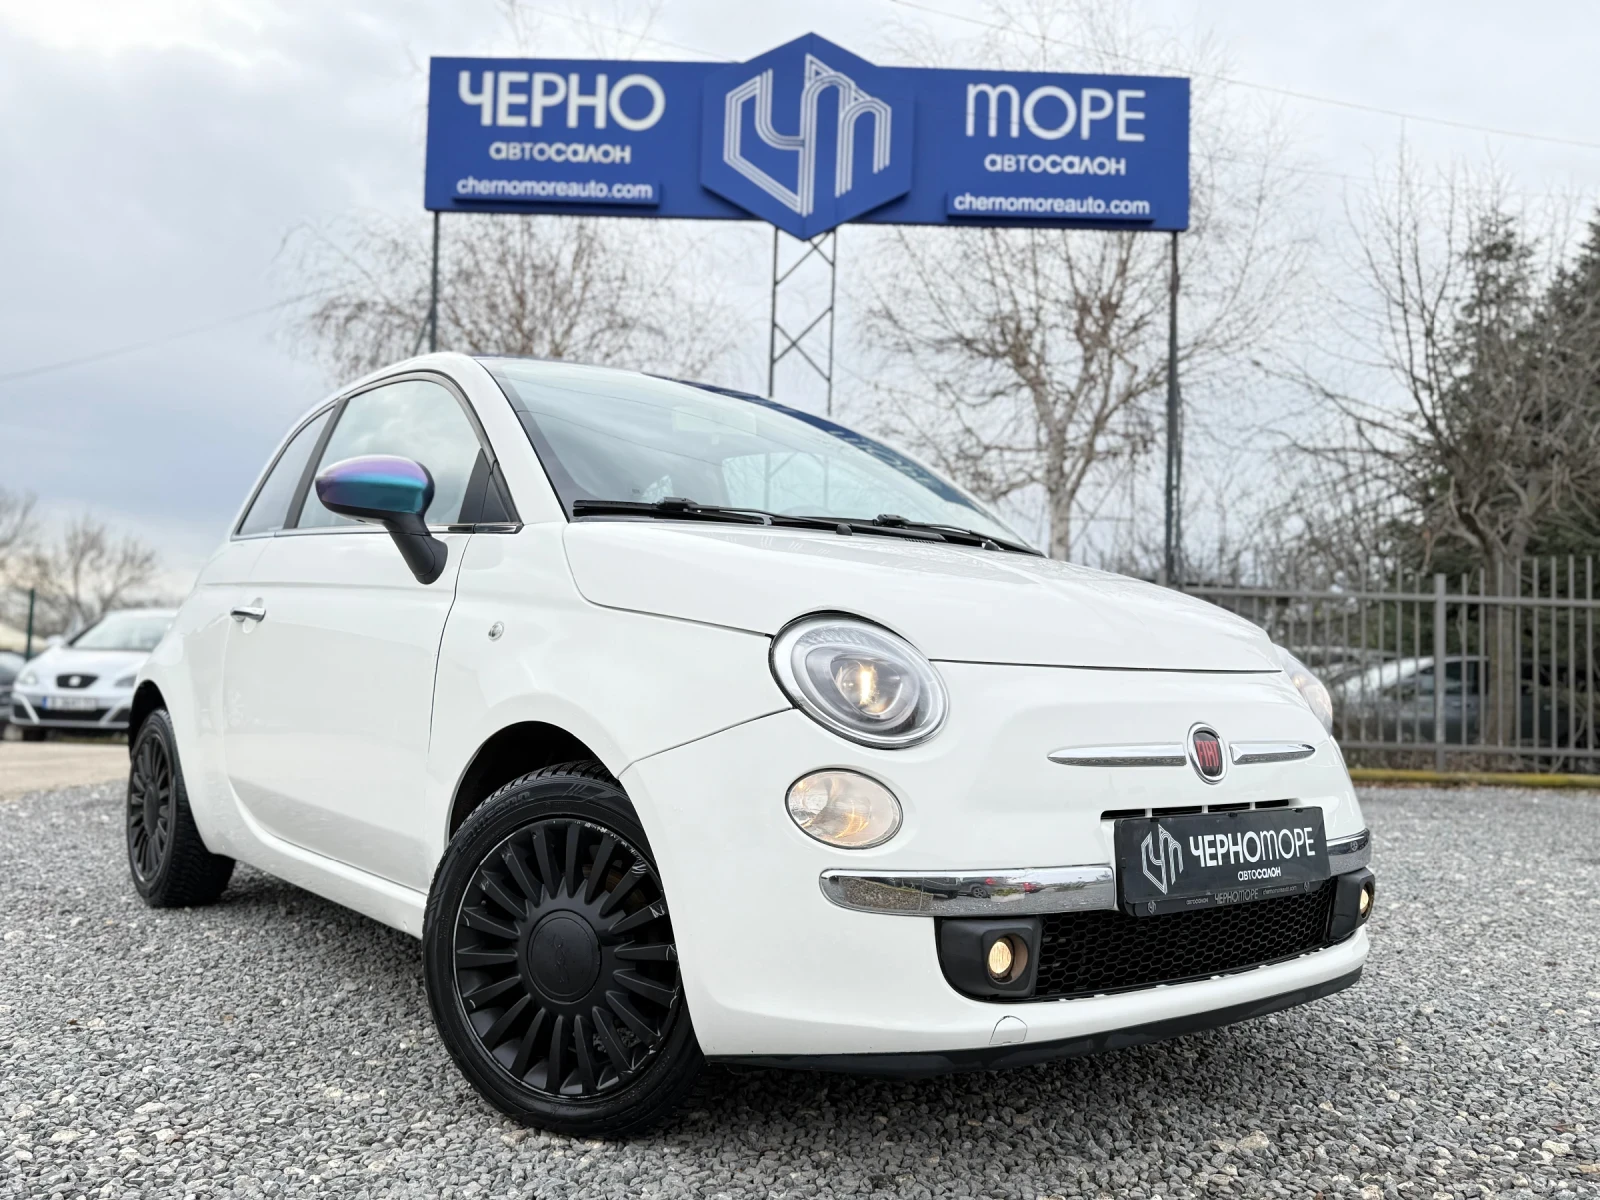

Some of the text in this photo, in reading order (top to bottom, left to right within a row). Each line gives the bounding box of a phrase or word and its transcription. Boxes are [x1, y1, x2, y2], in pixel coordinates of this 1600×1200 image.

[458, 70, 666, 132] ЧЕРНО
[489, 141, 631, 164] автосалон
[984, 153, 1127, 176] автосалон
[456, 176, 653, 199] chernomoreauto.com
[953, 192, 1150, 215] chernomoreauto.com
[1195, 740, 1220, 767] FIAT
[1237, 866, 1282, 881] автосалон
